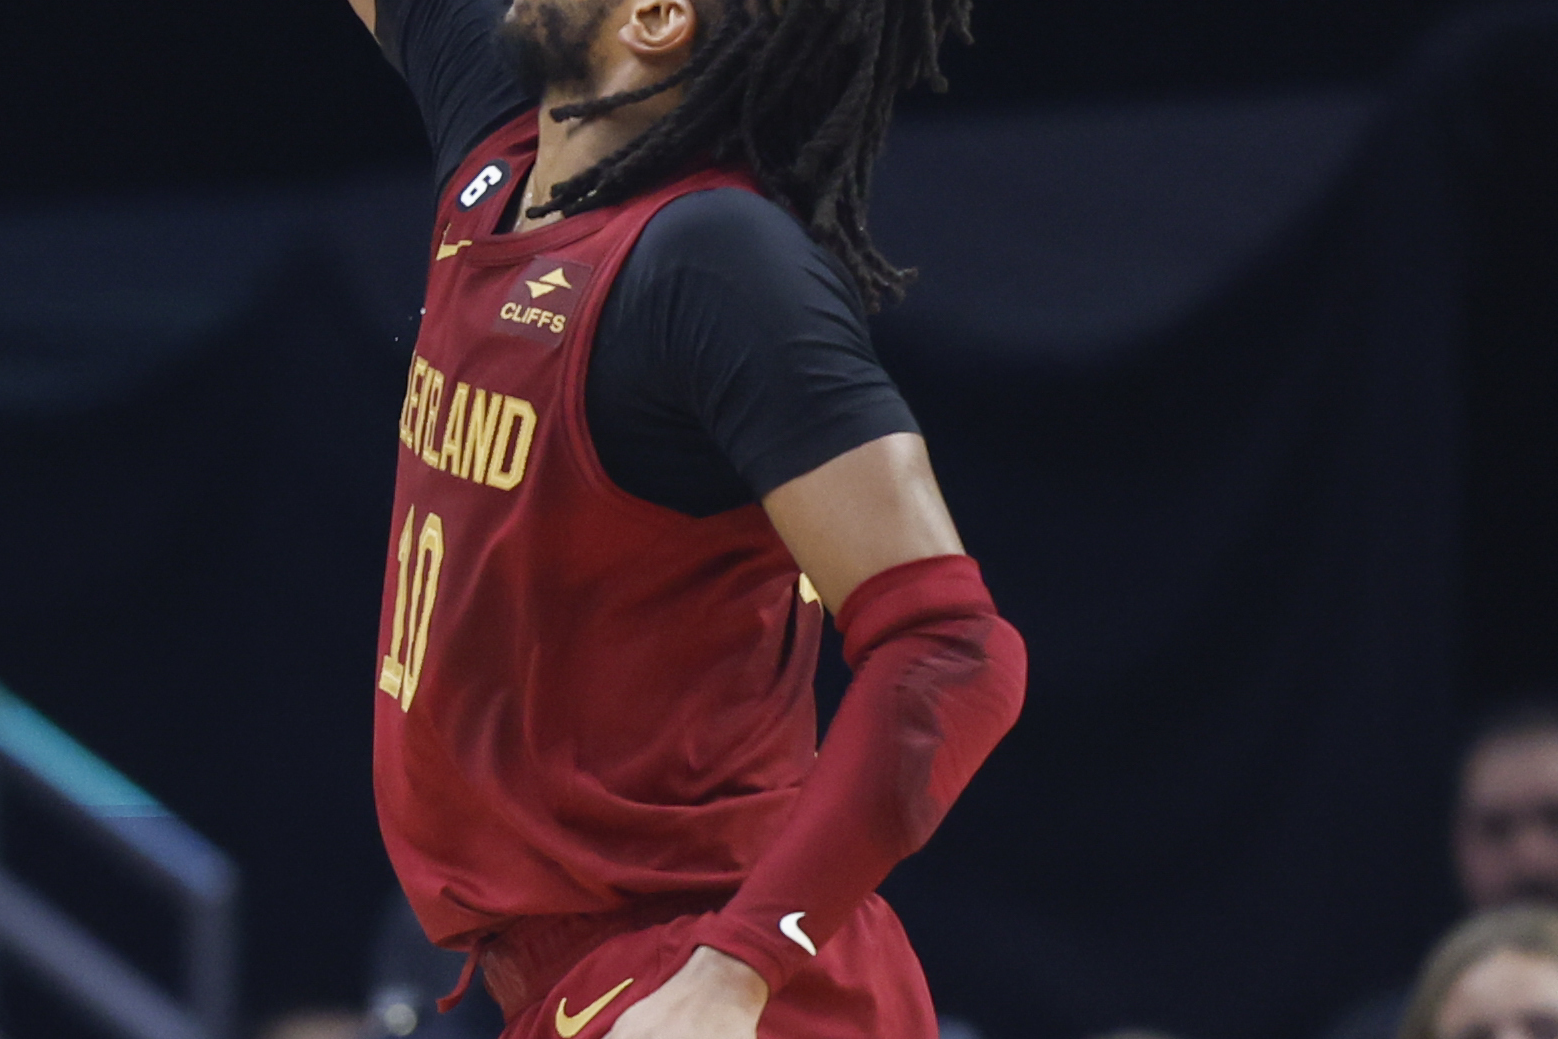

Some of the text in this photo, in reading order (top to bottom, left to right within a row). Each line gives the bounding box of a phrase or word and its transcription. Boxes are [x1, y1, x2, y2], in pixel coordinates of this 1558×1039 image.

[460, 164, 503, 208] 6
[500, 302, 566, 334] CLIFFS
[378, 503, 445, 714] 10
